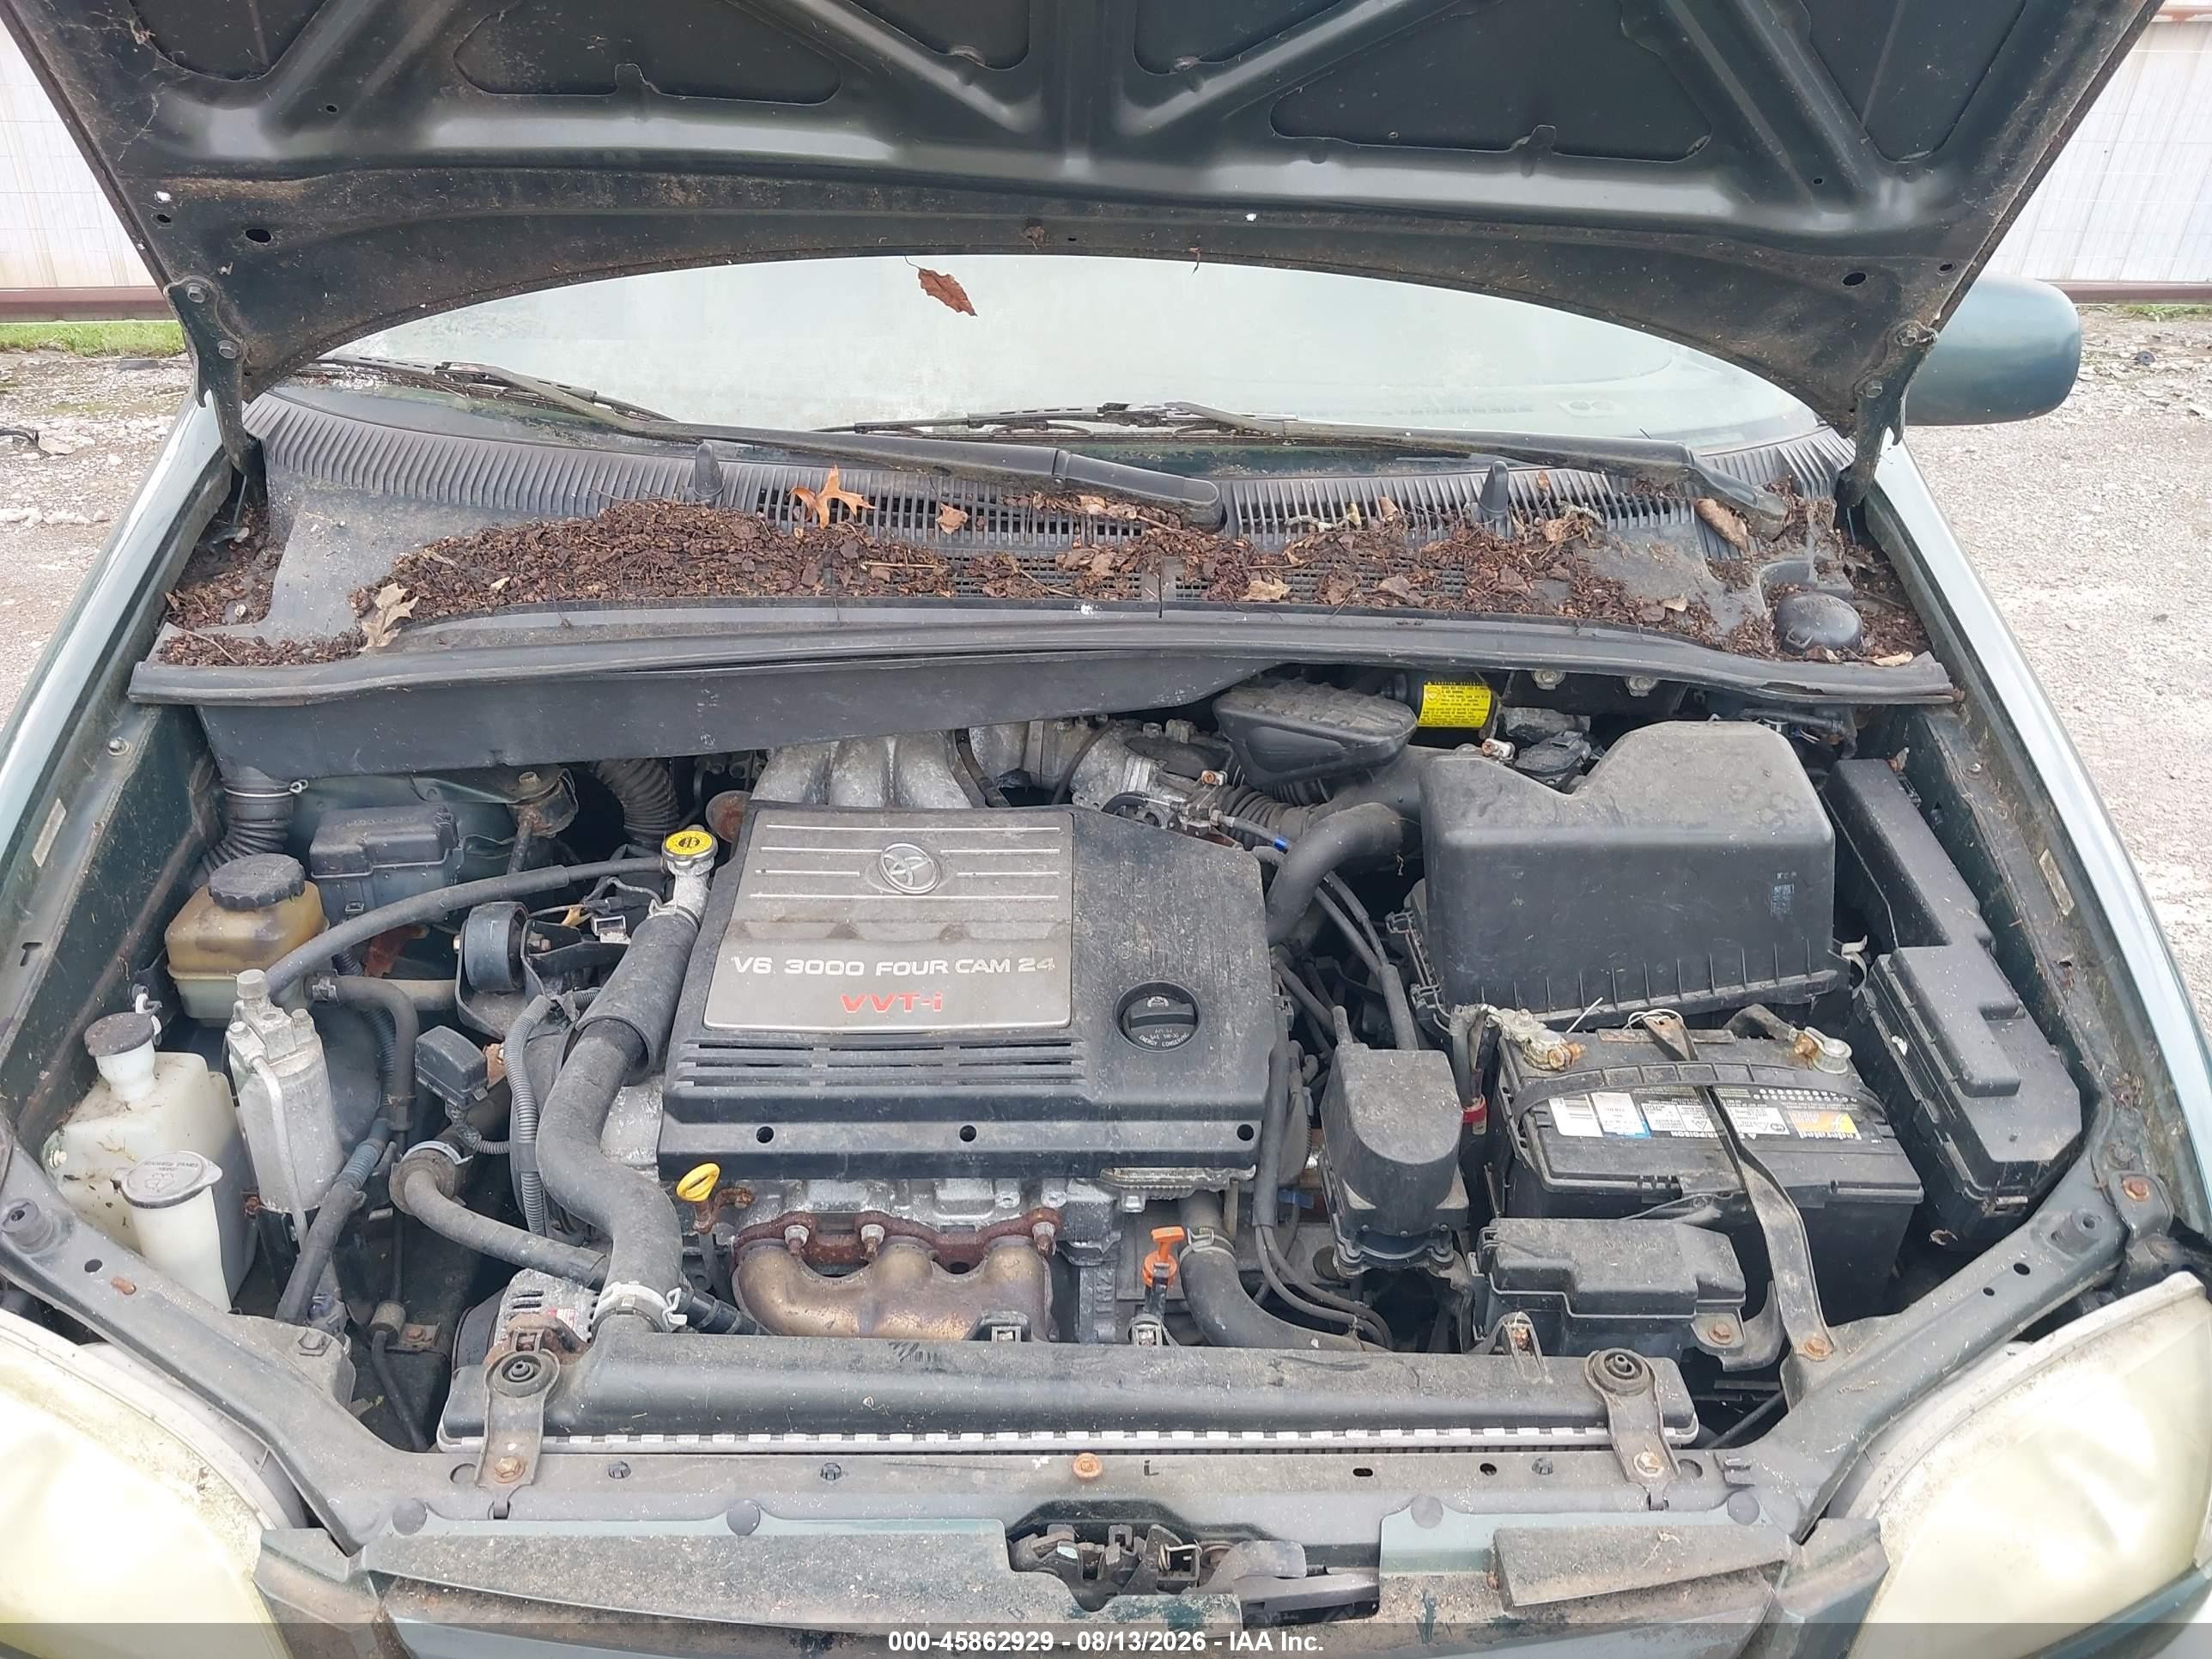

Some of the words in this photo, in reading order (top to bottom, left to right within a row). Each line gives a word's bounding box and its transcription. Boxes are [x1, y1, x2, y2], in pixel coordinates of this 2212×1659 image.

[733, 957, 773, 974] V6
[784, 959, 865, 976] 3000
[875, 959, 949, 976] FOUR
[955, 958, 1011, 974] CAM
[1018, 957, 1055, 973] 24
[840, 992, 943, 1014] VVT-i
